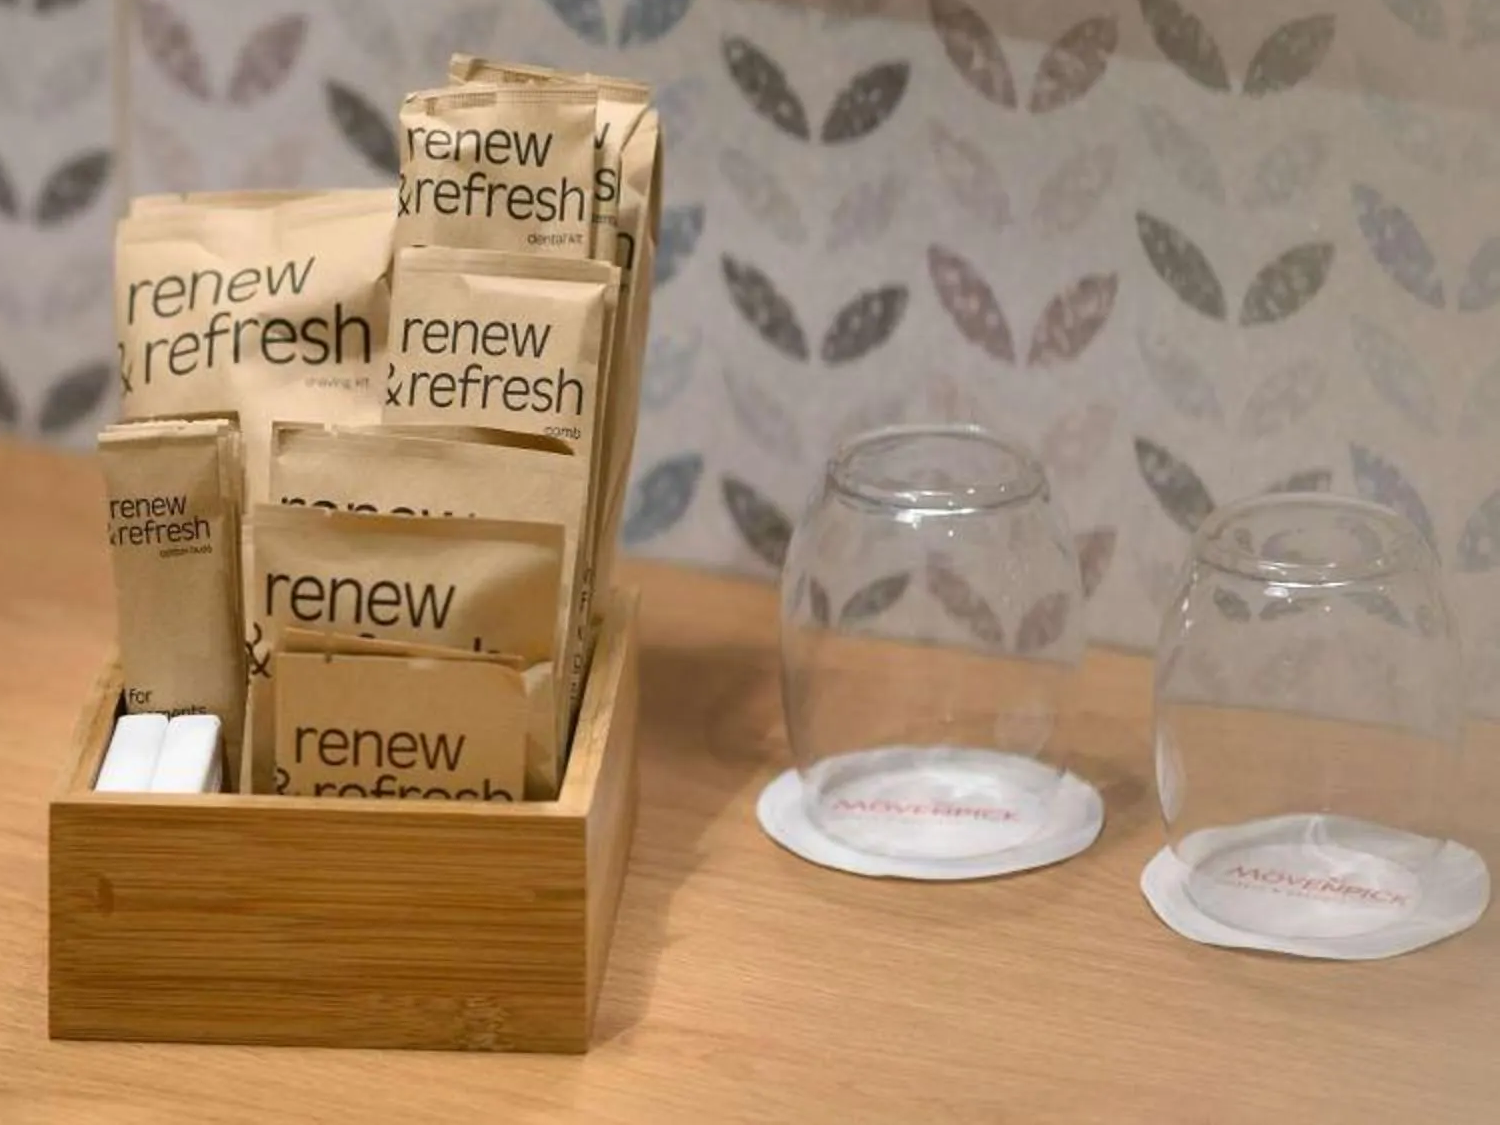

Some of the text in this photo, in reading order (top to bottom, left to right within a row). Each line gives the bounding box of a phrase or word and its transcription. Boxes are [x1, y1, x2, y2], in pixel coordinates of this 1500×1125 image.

[407, 126, 553, 167] renew
[415, 172, 585, 222] refresh
[127, 256, 315, 325] renew
[145, 302, 371, 385] refresh
[402, 317, 551, 358] renew
[408, 363, 583, 416] refresh
[109, 494, 187, 520] renew
[266, 573, 456, 629] renew
[295, 726, 466, 772] renew
